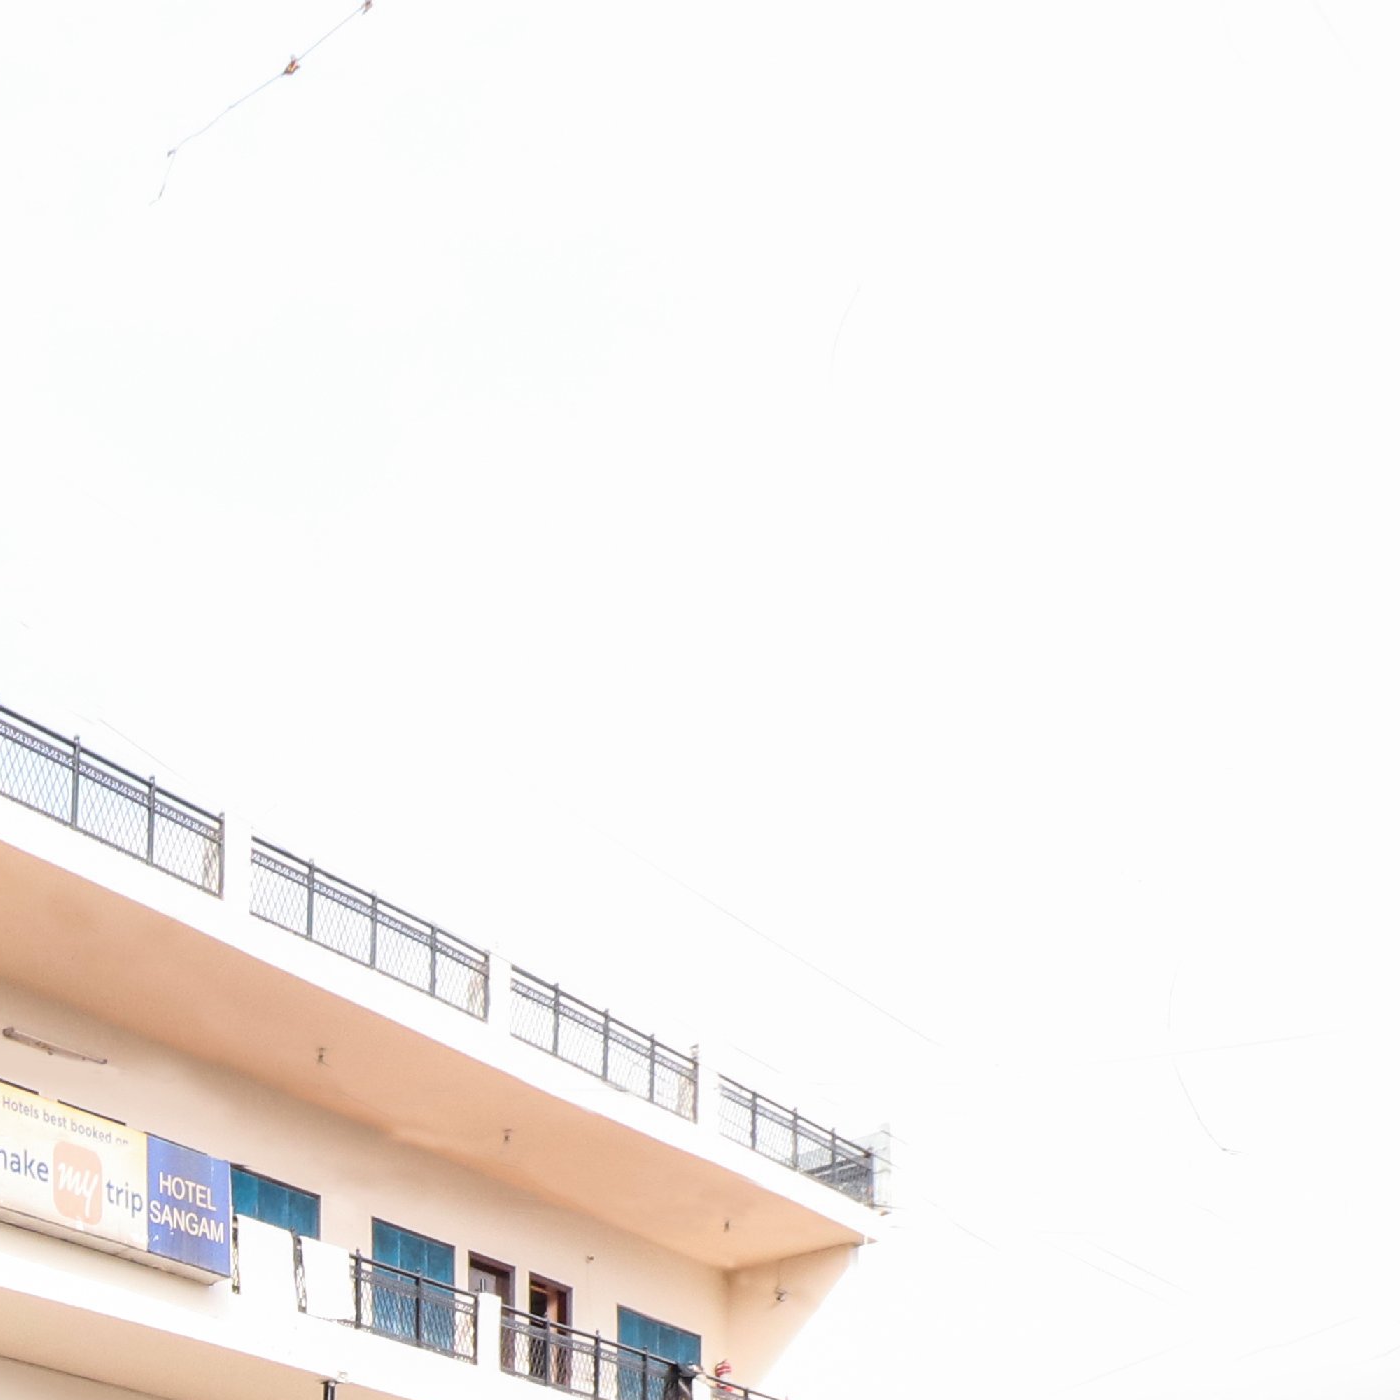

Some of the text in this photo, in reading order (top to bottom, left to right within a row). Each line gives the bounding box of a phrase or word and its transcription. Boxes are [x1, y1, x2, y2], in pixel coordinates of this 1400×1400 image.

[2, 1096, 40, 1121] Hotels
[43, 1110, 68, 1129] best
[70, 1119, 113, 1145] booked
[58, 1161, 99, 1216] my
[106, 1181, 143, 1217] trip
[159, 1171, 217, 1211] HOTEL
[150, 1200, 225, 1244] SANGAM
